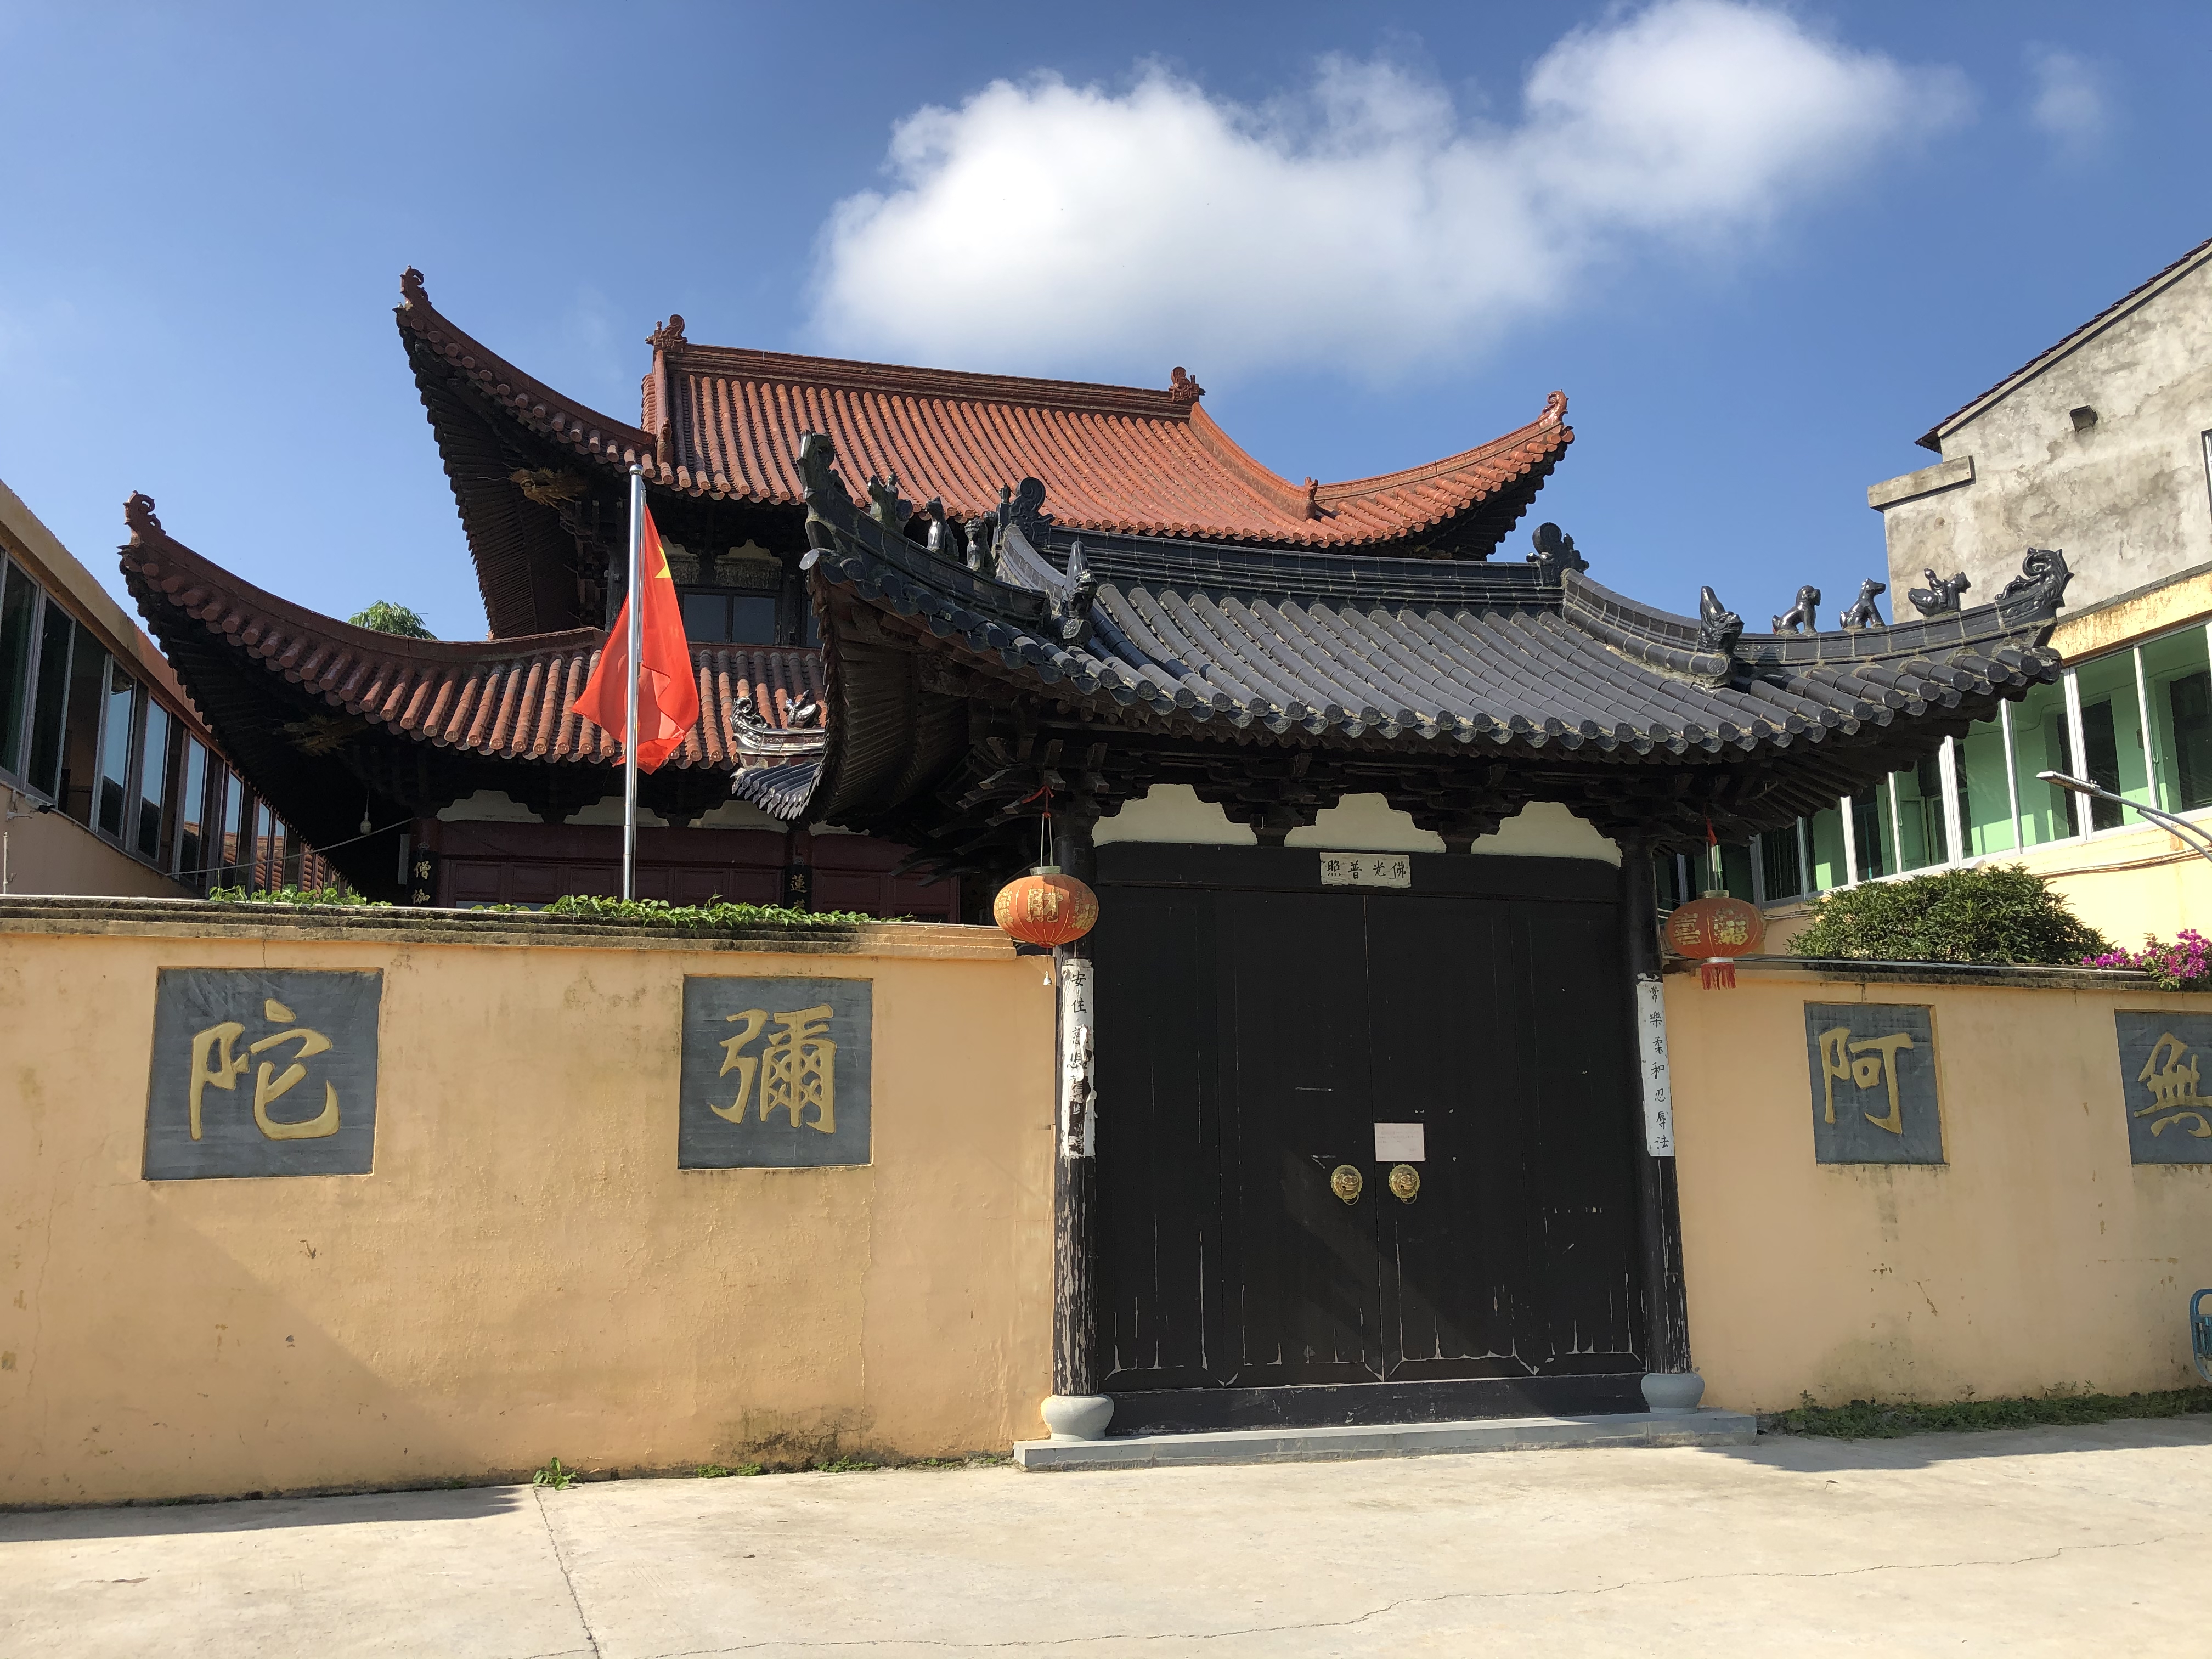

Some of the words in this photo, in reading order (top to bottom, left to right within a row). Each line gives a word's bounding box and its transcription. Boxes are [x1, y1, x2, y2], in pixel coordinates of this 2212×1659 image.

[1025, 887, 1063, 923] 財
[190, 998, 341, 1141] 陀
[710, 1003, 837, 1135] 彌
[1649, 985, 1669, 1149] 常樂柔和忍辱法
[1819, 1026, 1914, 1135] 阿
[2133, 1032, 2212, 1138] 無
